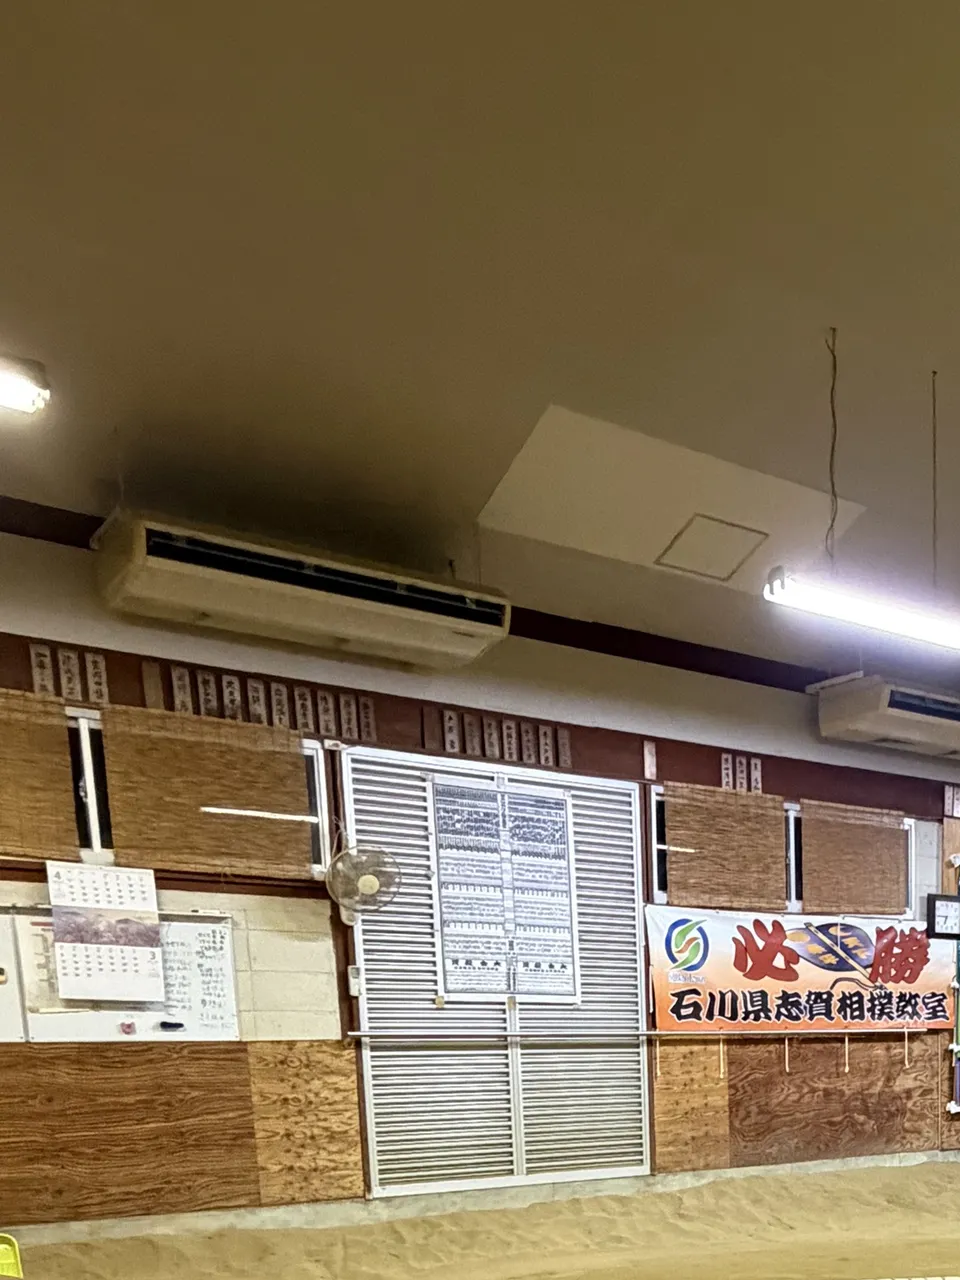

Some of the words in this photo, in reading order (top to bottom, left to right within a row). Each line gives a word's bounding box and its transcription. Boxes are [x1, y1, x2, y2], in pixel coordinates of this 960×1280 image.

[149, 951, 156, 960] 3
[670, 988, 949, 1021] 石川県志賀相撲教室
